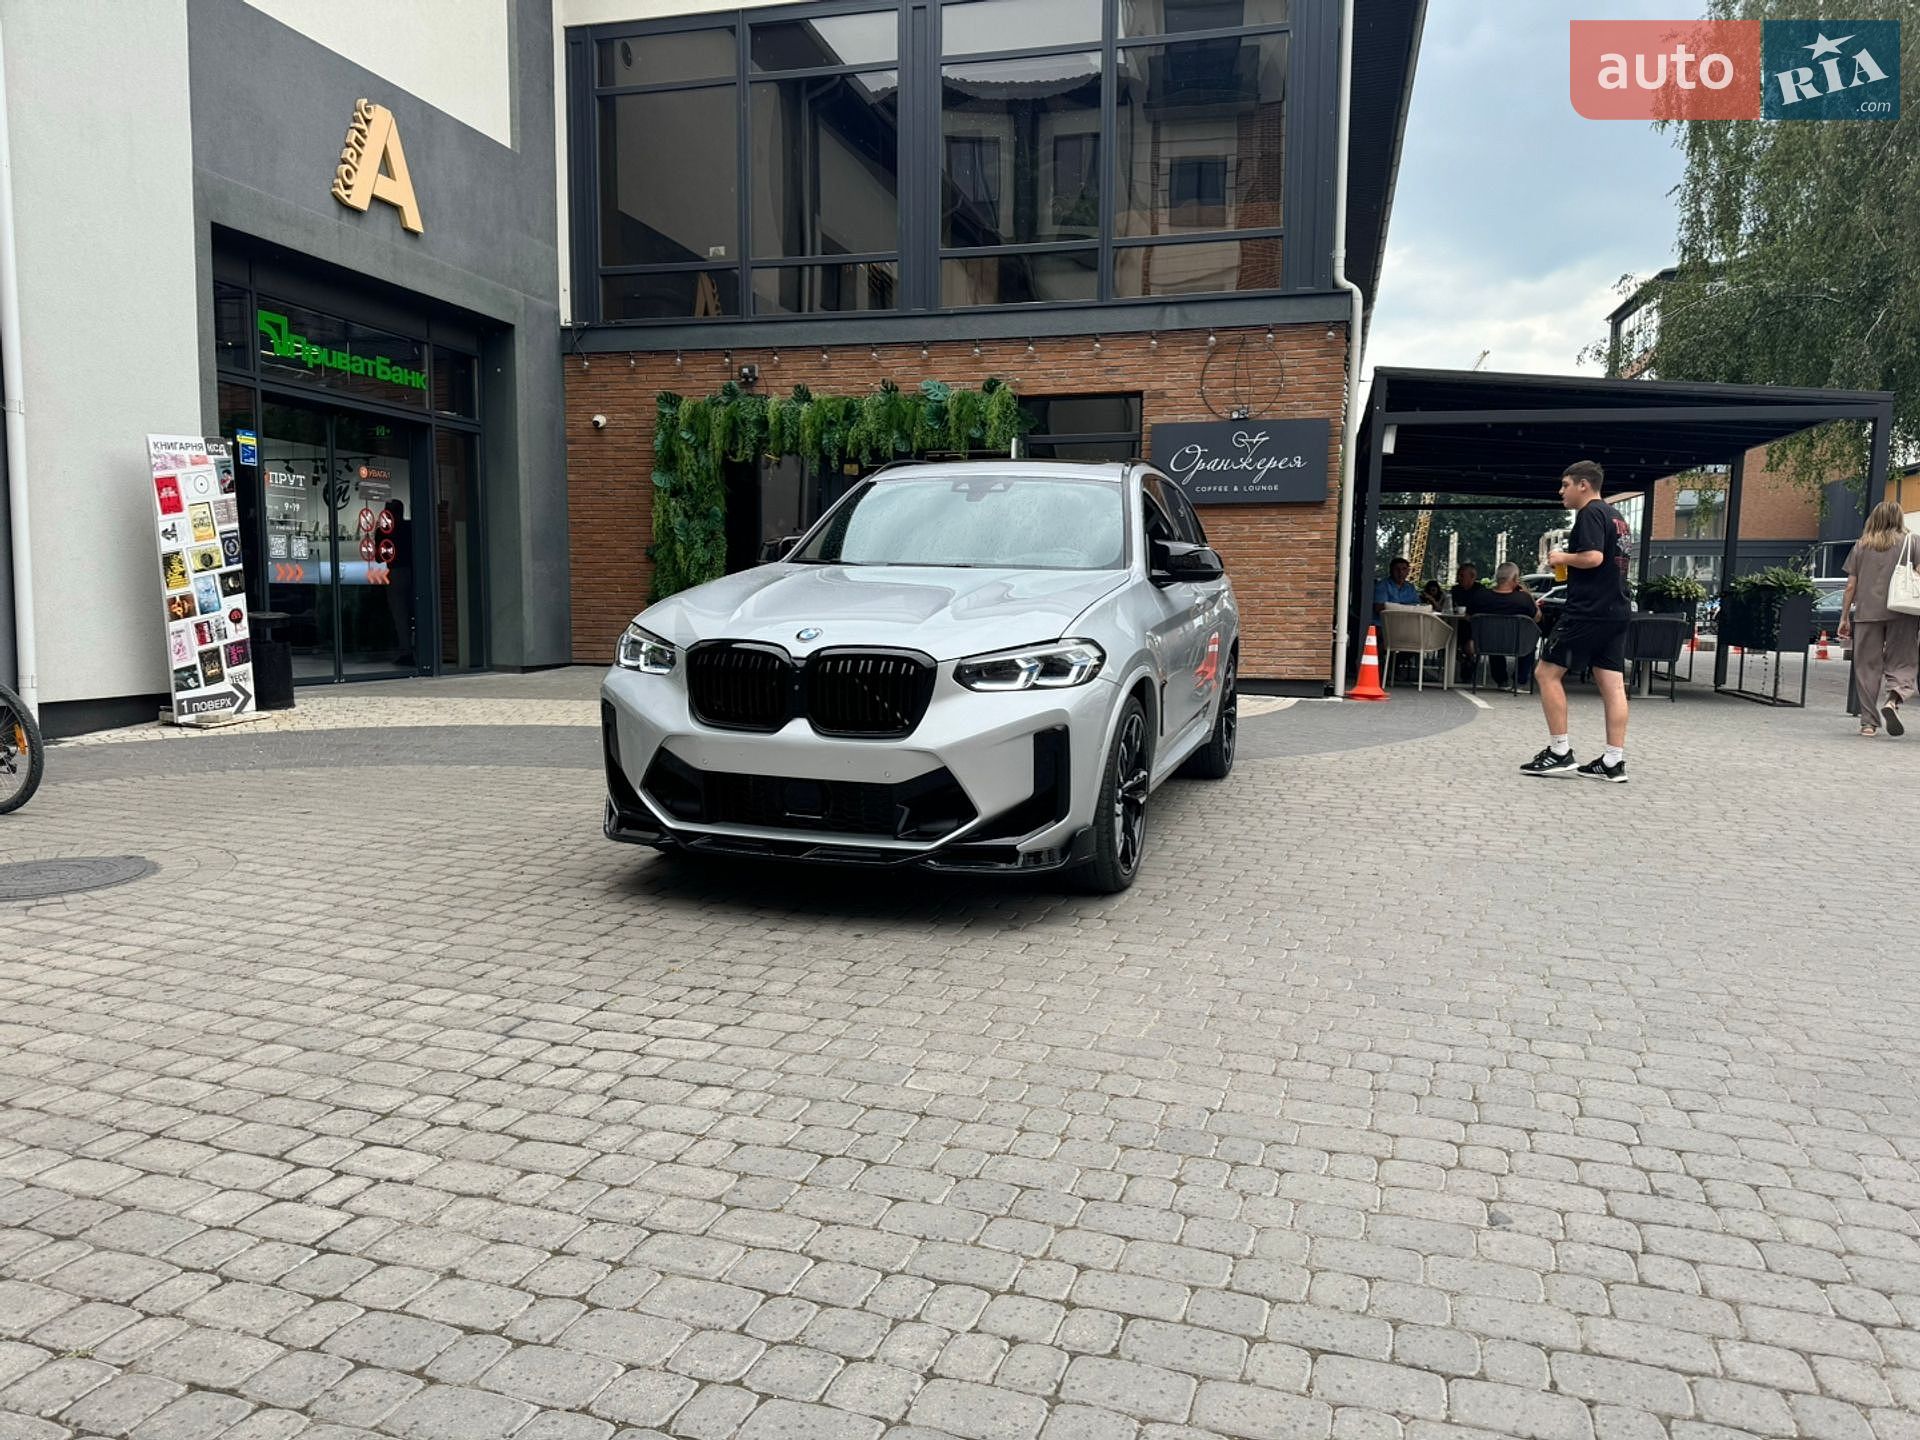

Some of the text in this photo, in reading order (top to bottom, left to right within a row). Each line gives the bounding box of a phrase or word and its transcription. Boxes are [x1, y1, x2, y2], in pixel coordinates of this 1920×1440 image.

[331, 98, 375, 201] КОРПУС
[289, 333, 428, 391] ПриватБанк
[153, 441, 205, 451] КНИГАРНЯ
[1169, 443, 1308, 485] Оранжерея
[1195, 485, 1228, 493] COFFEE
[1243, 484, 1279, 492] LOUNGE
[181, 697, 232, 713] 1 ПОВЕРХ
